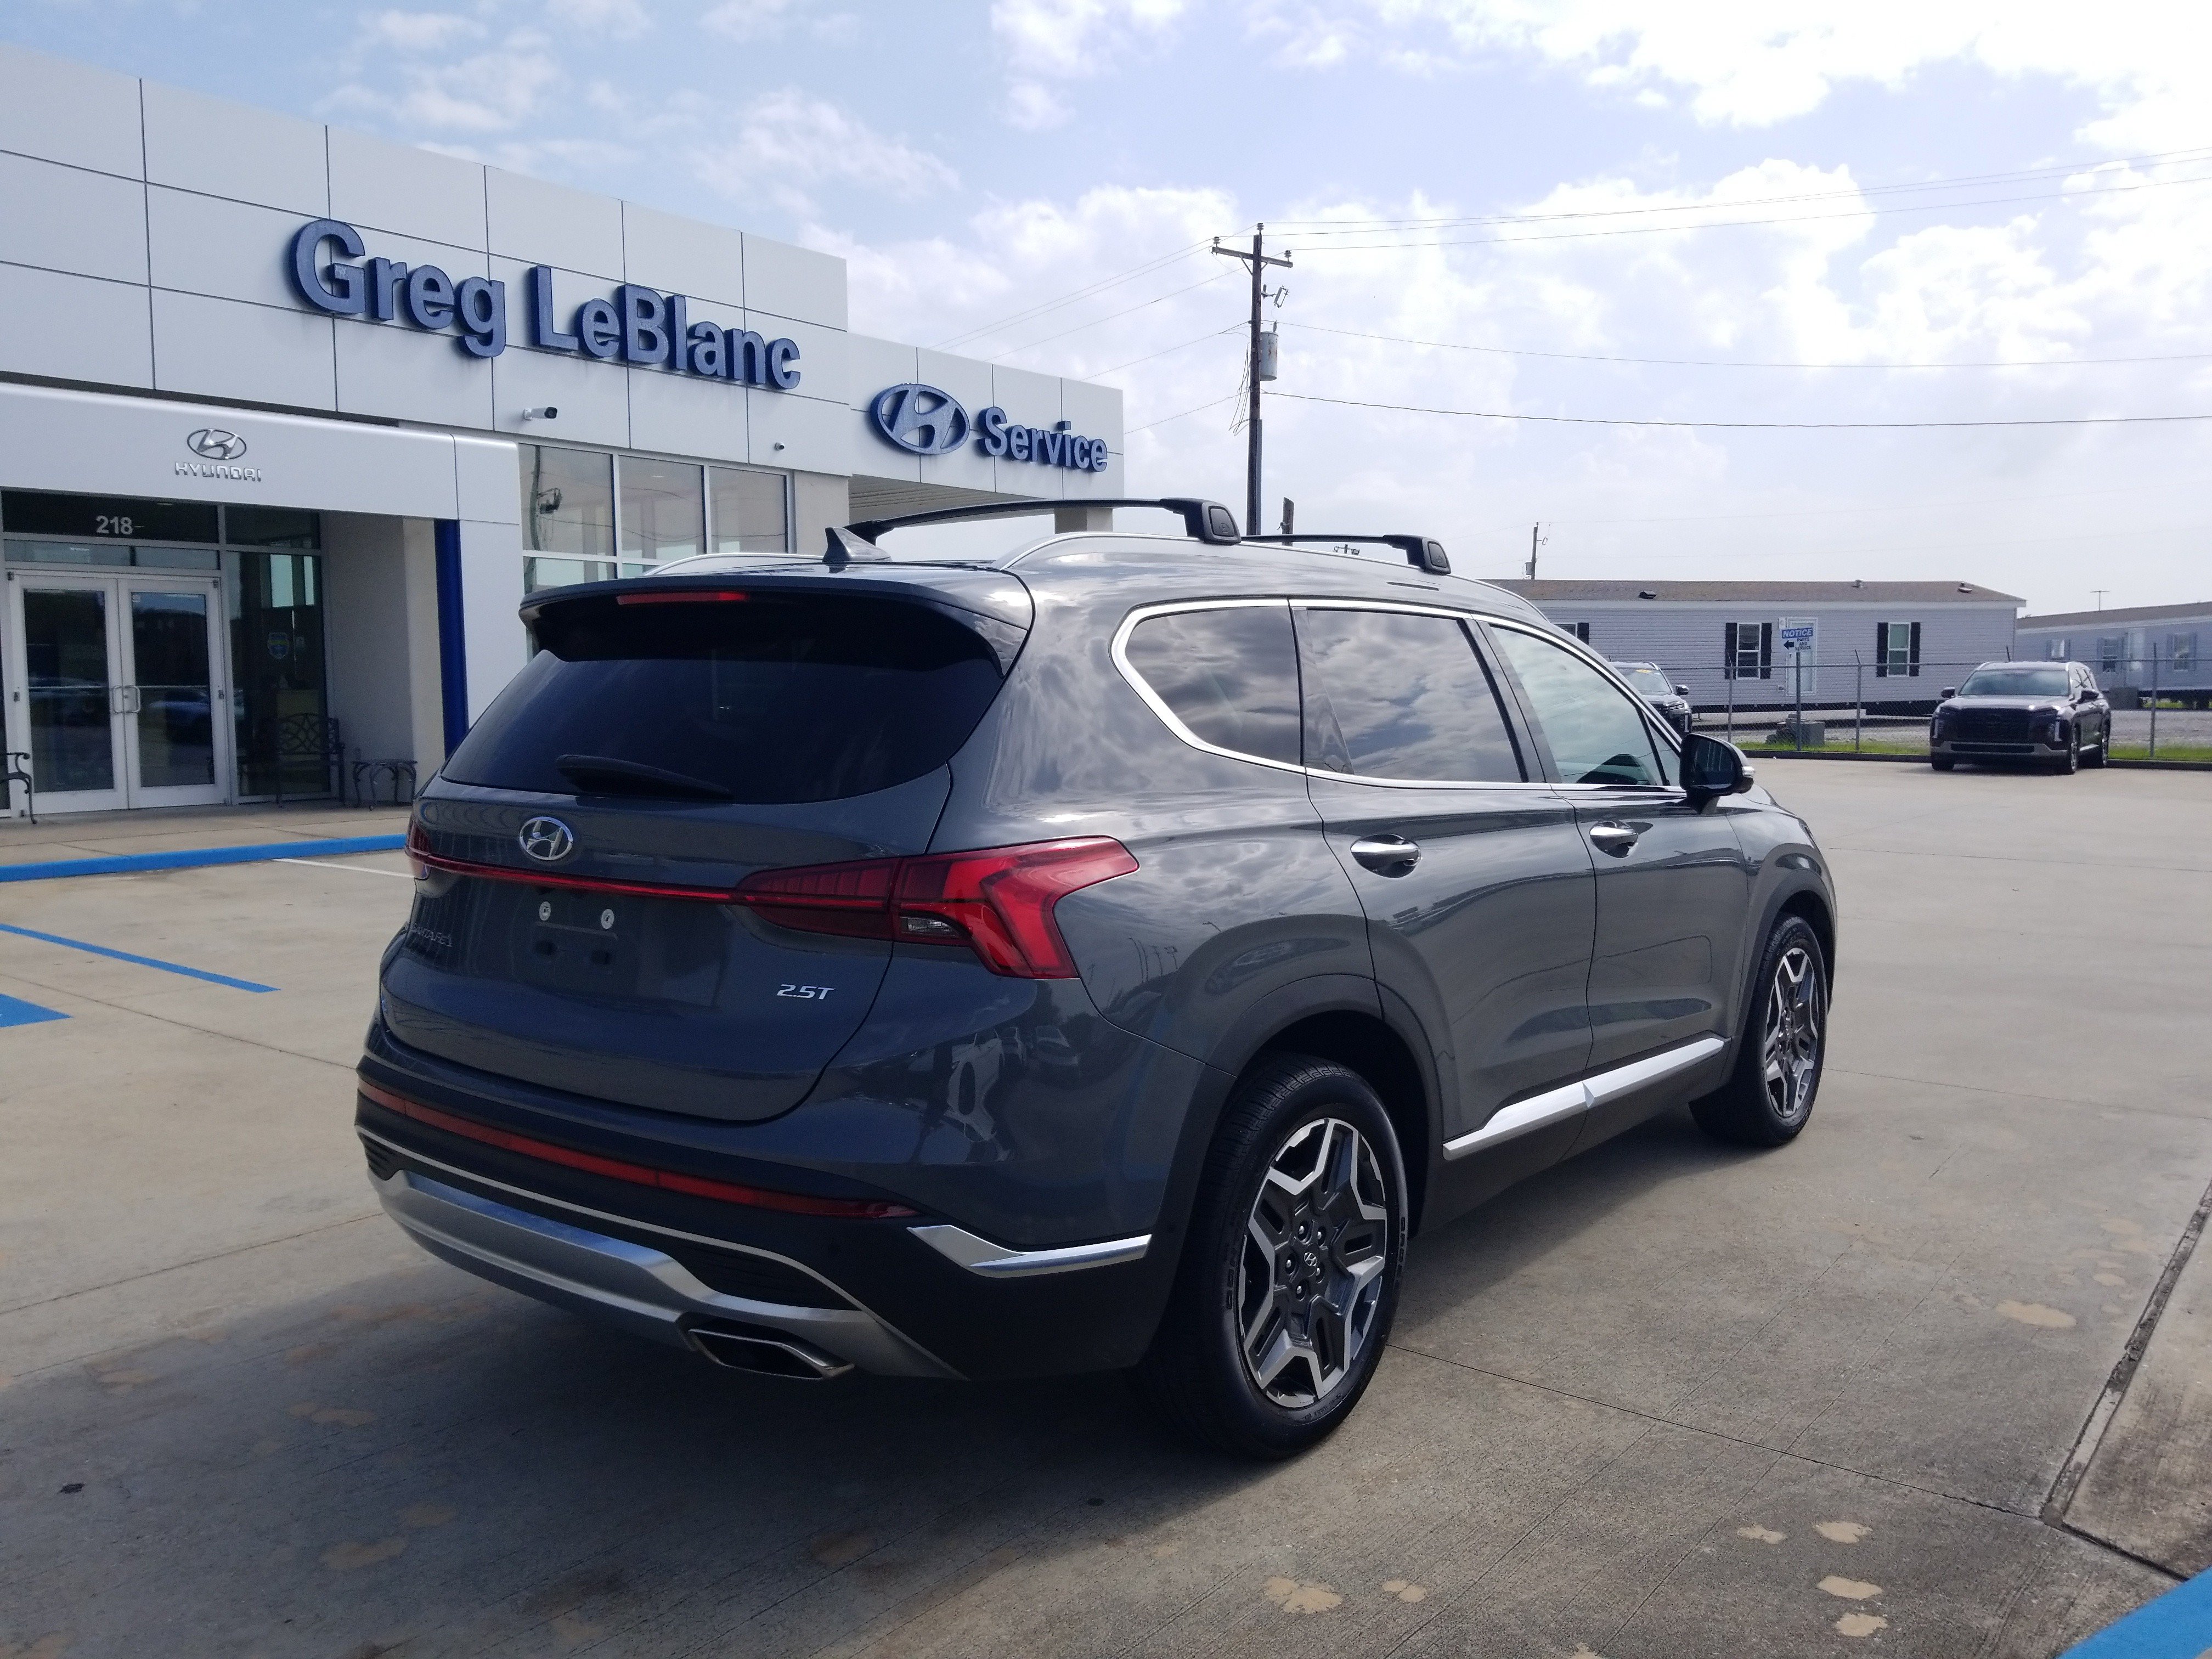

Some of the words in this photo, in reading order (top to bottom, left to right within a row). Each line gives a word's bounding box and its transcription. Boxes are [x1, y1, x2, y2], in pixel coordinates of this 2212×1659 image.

[289, 219, 506, 358] Greg
[532, 266, 800, 389] LeBlanc
[978, 407, 1108, 472] Service
[175, 462, 261, 482] HYUNDAI
[96, 516, 133, 534] 218
[1782, 629, 1812, 637] NOTICE
[777, 984, 836, 1000] 2.5T
